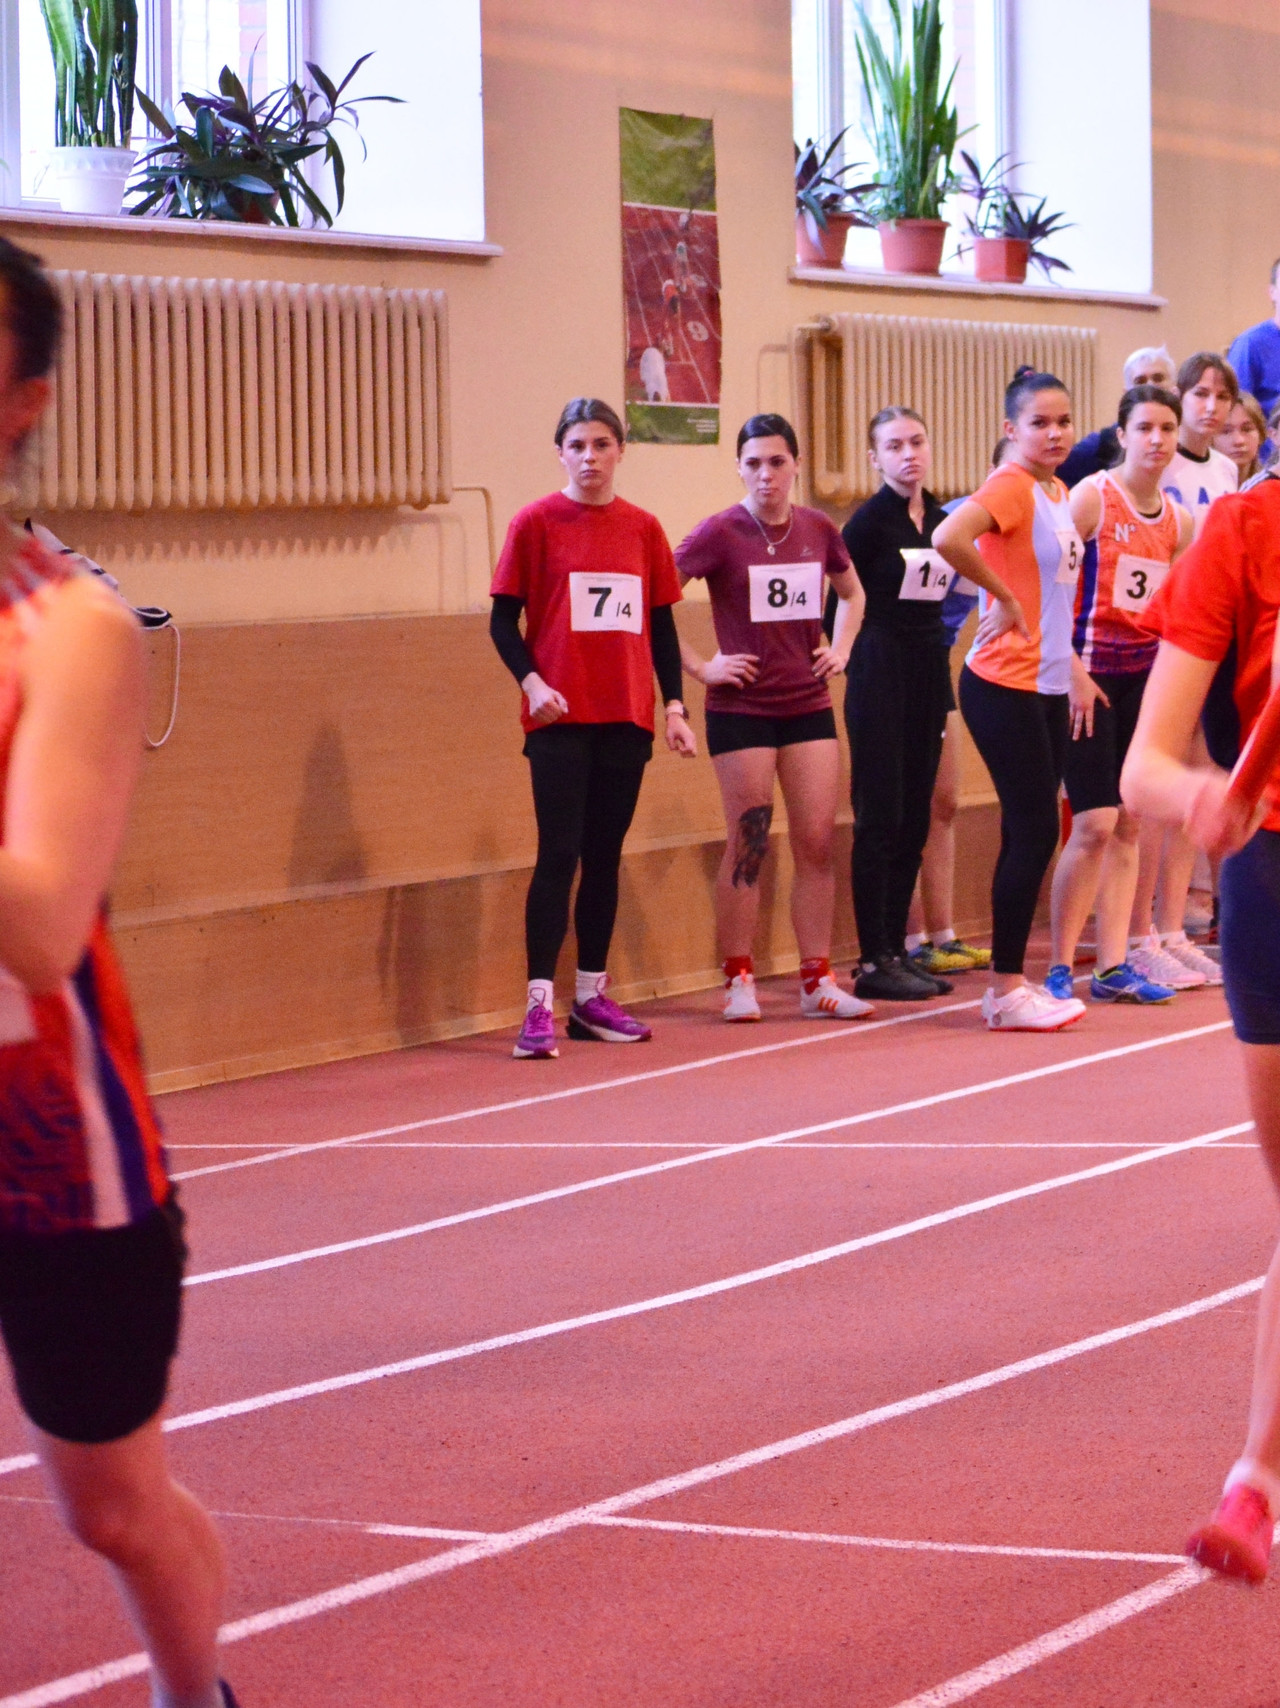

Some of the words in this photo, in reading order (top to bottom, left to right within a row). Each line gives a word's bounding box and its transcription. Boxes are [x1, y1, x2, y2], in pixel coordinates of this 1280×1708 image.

[918, 560, 947, 588] 1/4
[588, 587, 632, 618] 7/4
[767, 578, 807, 608] 8/4
